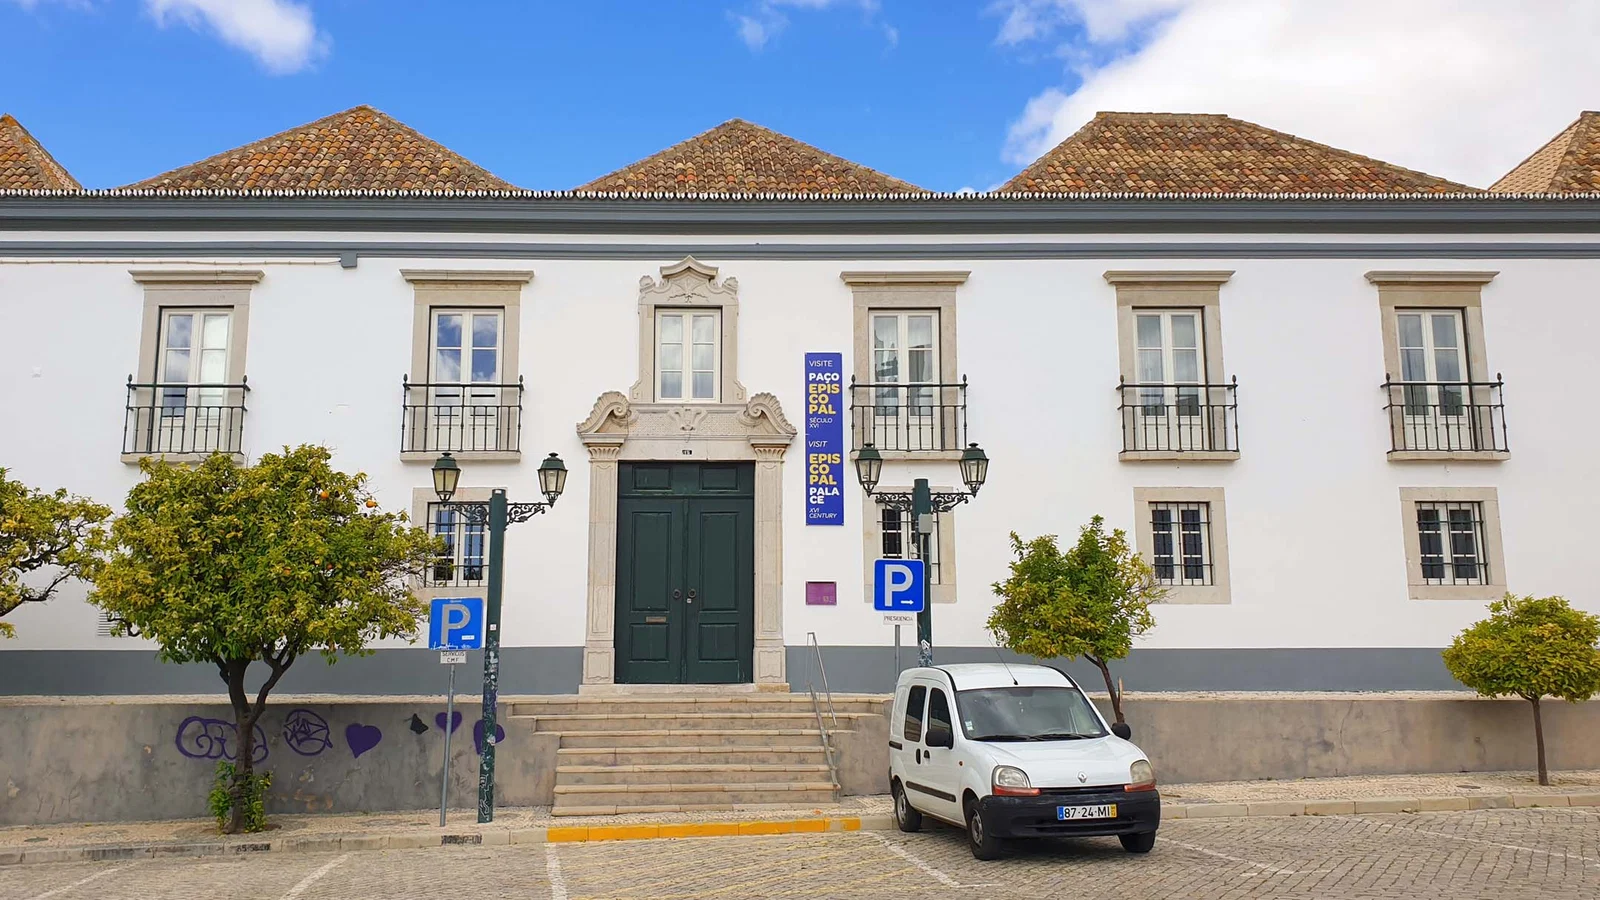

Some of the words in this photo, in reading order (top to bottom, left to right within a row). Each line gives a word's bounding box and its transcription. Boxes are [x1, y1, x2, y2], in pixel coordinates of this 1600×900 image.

[809, 372, 840, 384] PAÇO
[809, 383, 840, 394] EPIS
[809, 393, 829, 404] CO
[809, 404, 836, 415] PAL
[808, 440, 828, 448] VISIT
[809, 453, 841, 464] EPIS
[809, 464, 830, 475] CO
[809, 474, 837, 485] PAL
[809, 487, 840, 496] PALA
[809, 495, 825, 505] CE
[884, 564, 914, 607] P
[441, 603, 471, 645] P
